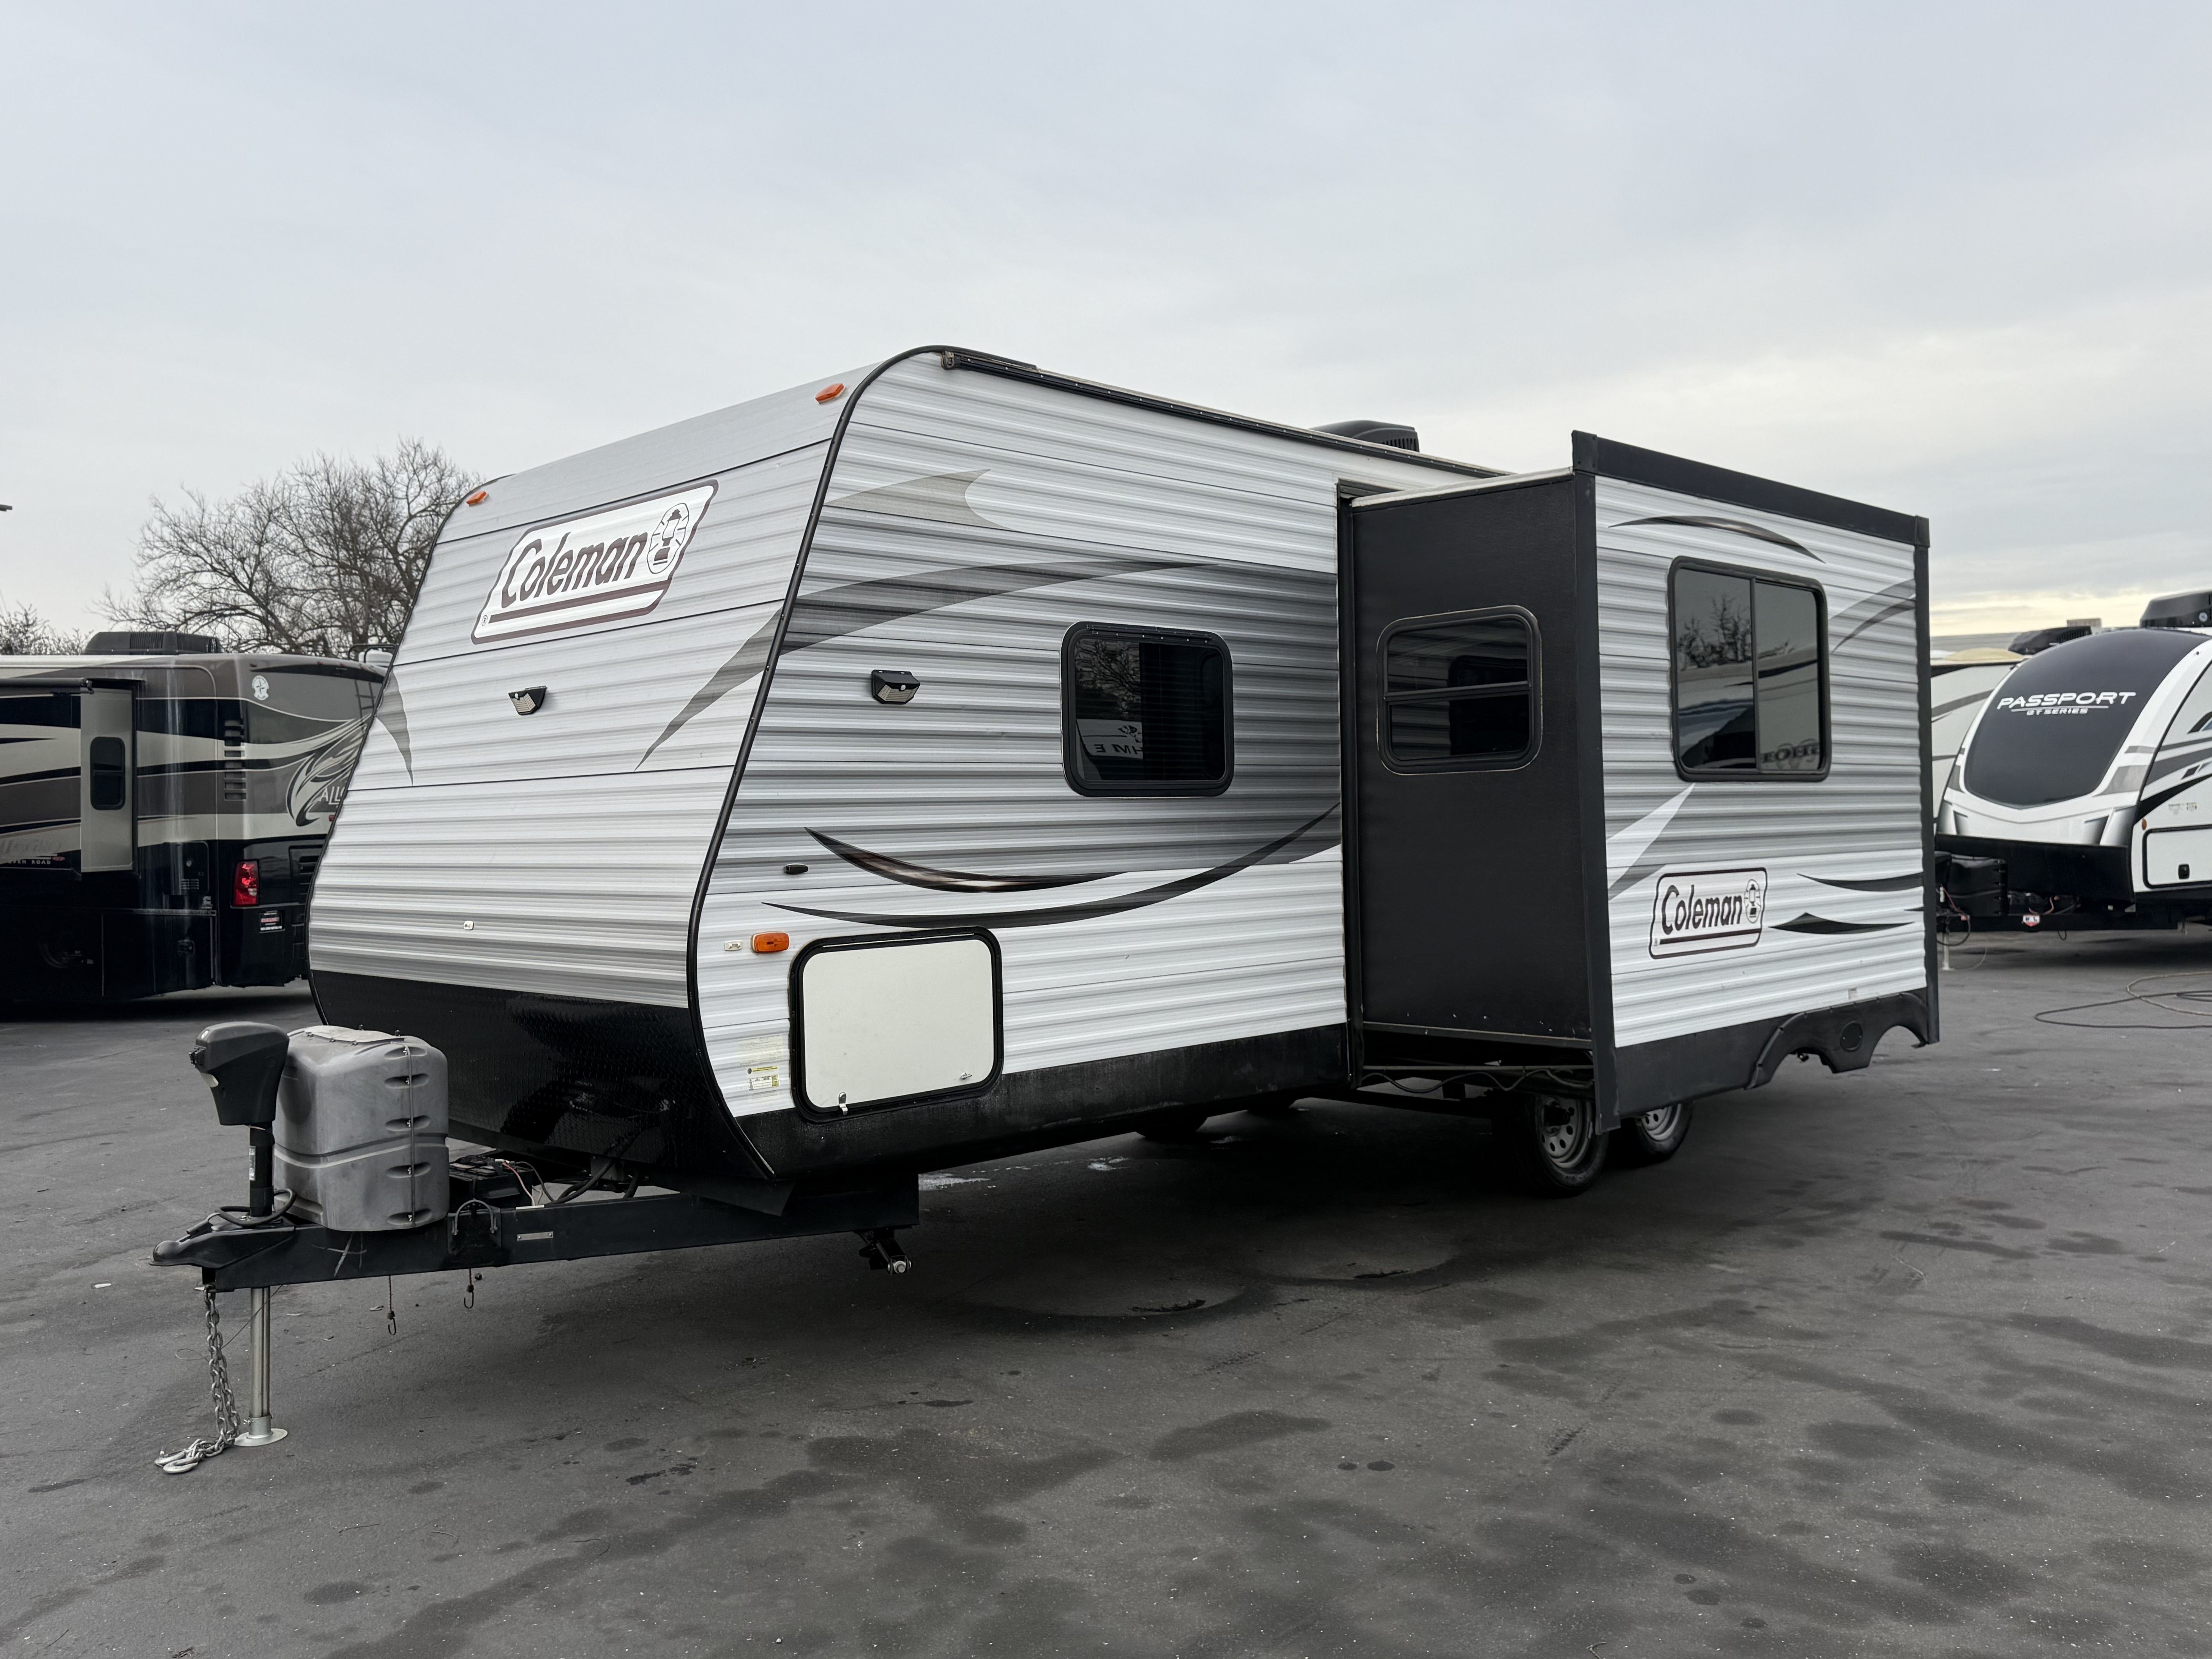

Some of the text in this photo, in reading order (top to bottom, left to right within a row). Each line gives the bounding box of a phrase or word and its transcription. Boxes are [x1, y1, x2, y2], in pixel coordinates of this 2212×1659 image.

[501, 532, 648, 608] Coleman
[1997, 692, 2136, 709] PASSPORT
[1661, 884, 1742, 935] Coleman
